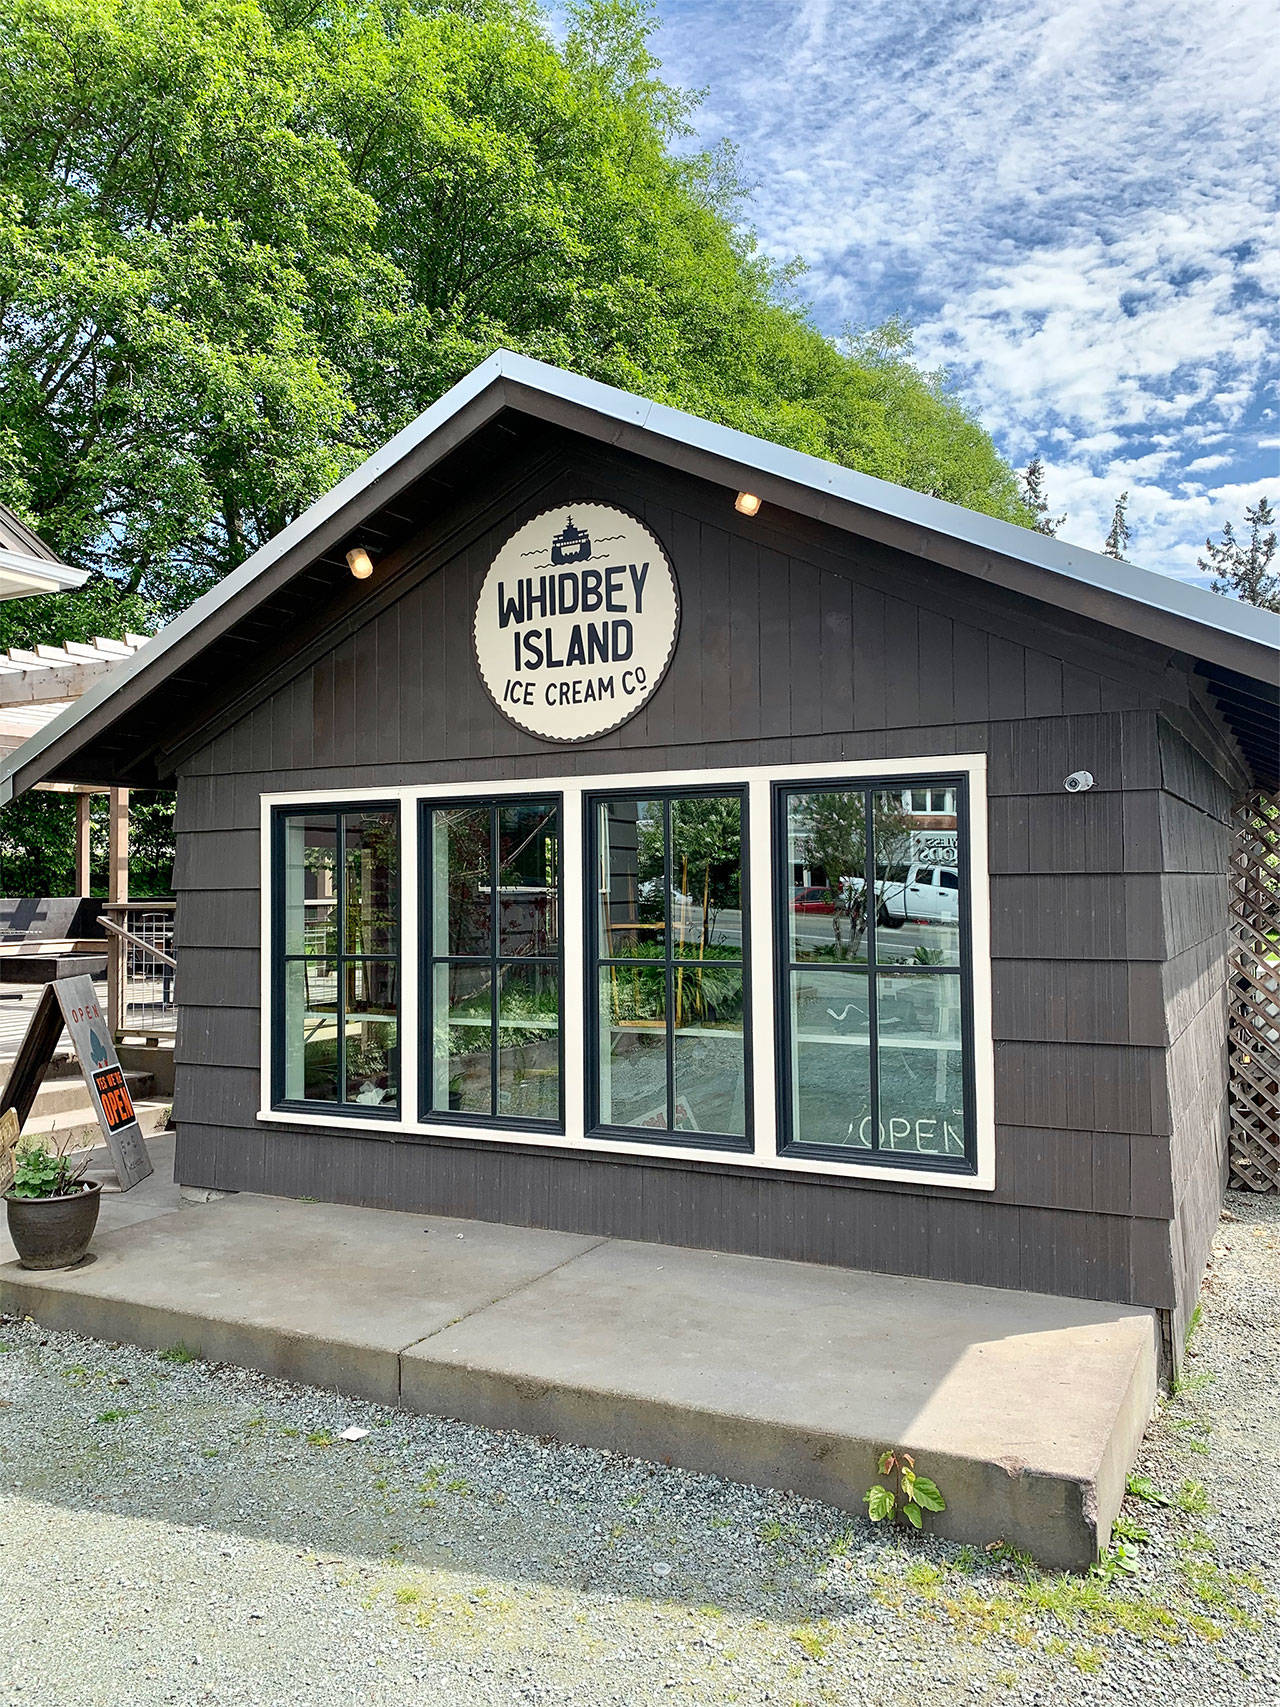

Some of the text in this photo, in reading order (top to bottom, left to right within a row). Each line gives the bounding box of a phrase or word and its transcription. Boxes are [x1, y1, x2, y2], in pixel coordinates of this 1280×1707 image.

[497, 562, 650, 629] WHIDBEY
[514, 619, 634, 672] ISLAND
[503, 679, 536, 706] ICE
[545, 676, 615, 706] CREAM
[71, 1003, 100, 1024] OPEN
[96, 1076, 108, 1091] YES
[101, 1086, 134, 1127] OPEN
[859, 1116, 965, 1154] OPEN
